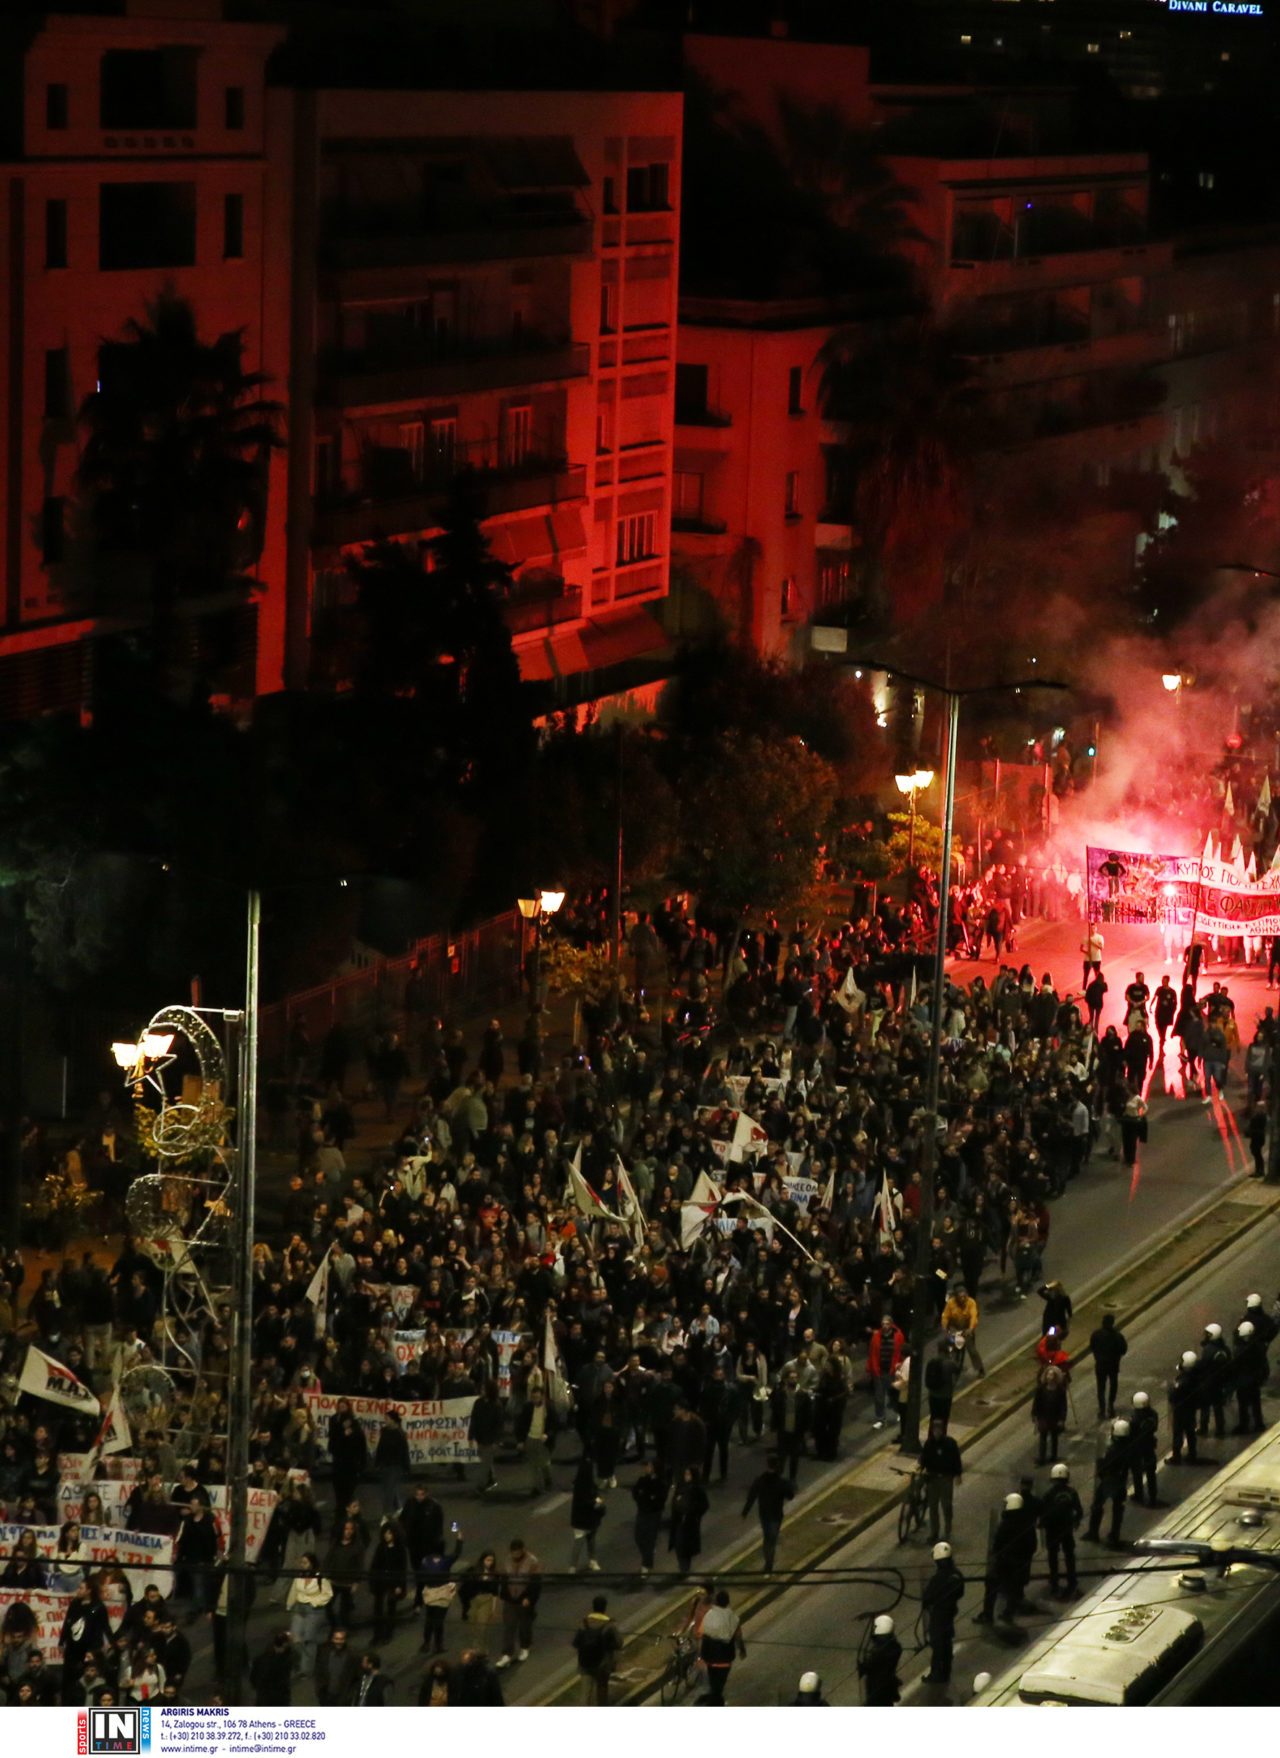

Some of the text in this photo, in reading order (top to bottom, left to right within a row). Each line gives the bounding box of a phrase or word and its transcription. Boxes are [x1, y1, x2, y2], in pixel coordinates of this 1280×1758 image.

[1169, 0, 1263, 15] DIVANI CARAVEL
[308, 1395, 407, 1417] ΠΟΛΤΕΧΝΕΙΟ
[115, 1531, 163, 1549] ΠΑΙΔΕΙΑ
